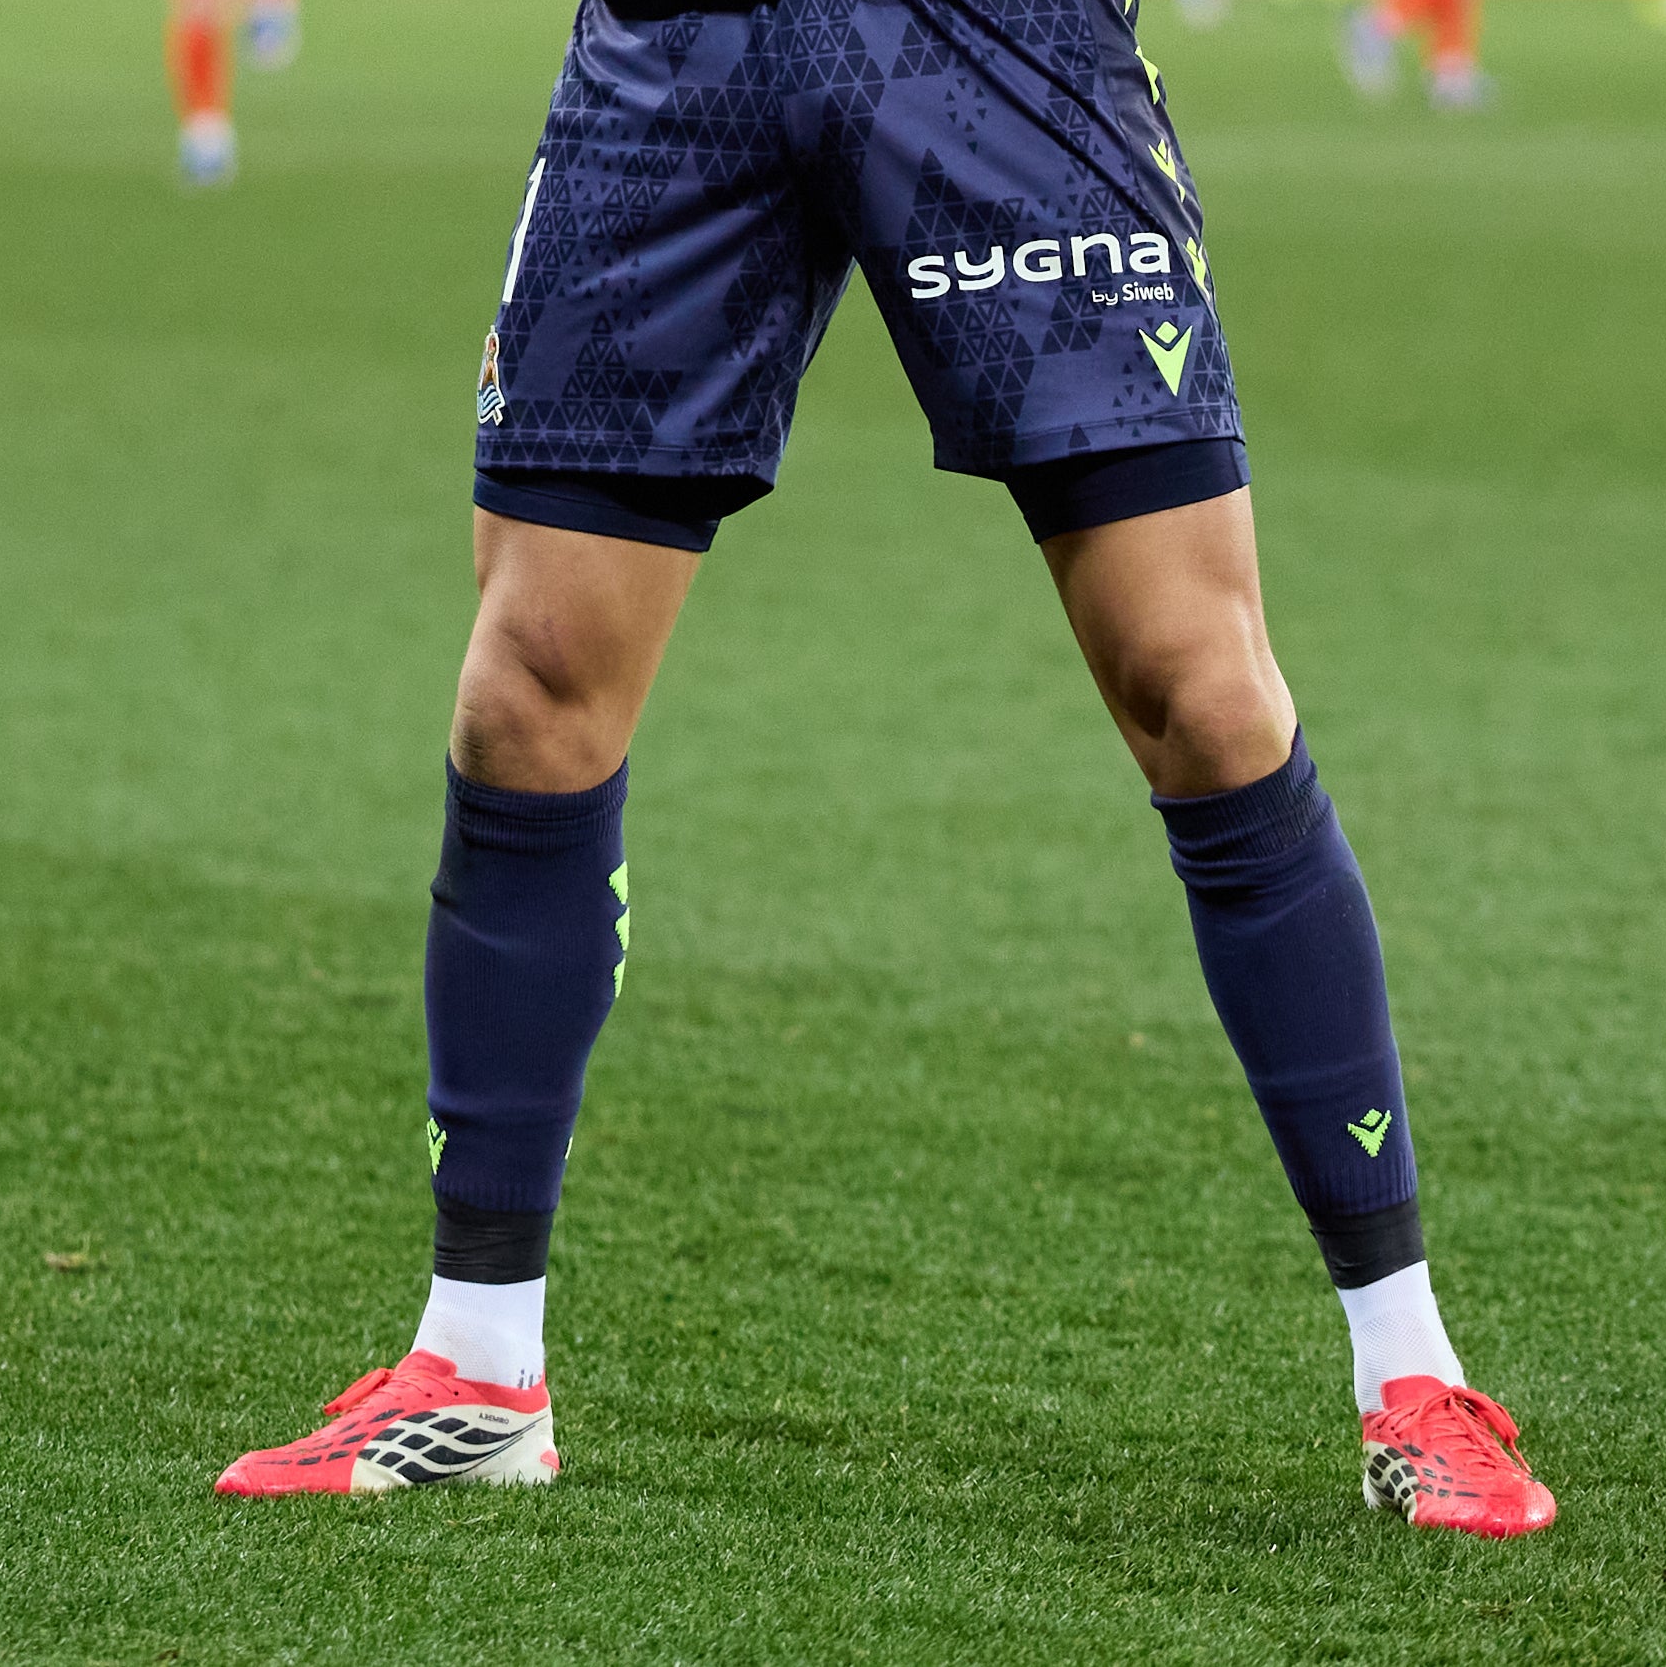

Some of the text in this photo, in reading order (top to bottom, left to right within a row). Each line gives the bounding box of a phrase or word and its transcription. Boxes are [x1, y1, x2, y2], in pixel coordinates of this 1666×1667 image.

[500, 156, 547, 304] 1
[1091, 281, 1175, 306] by Siweb
